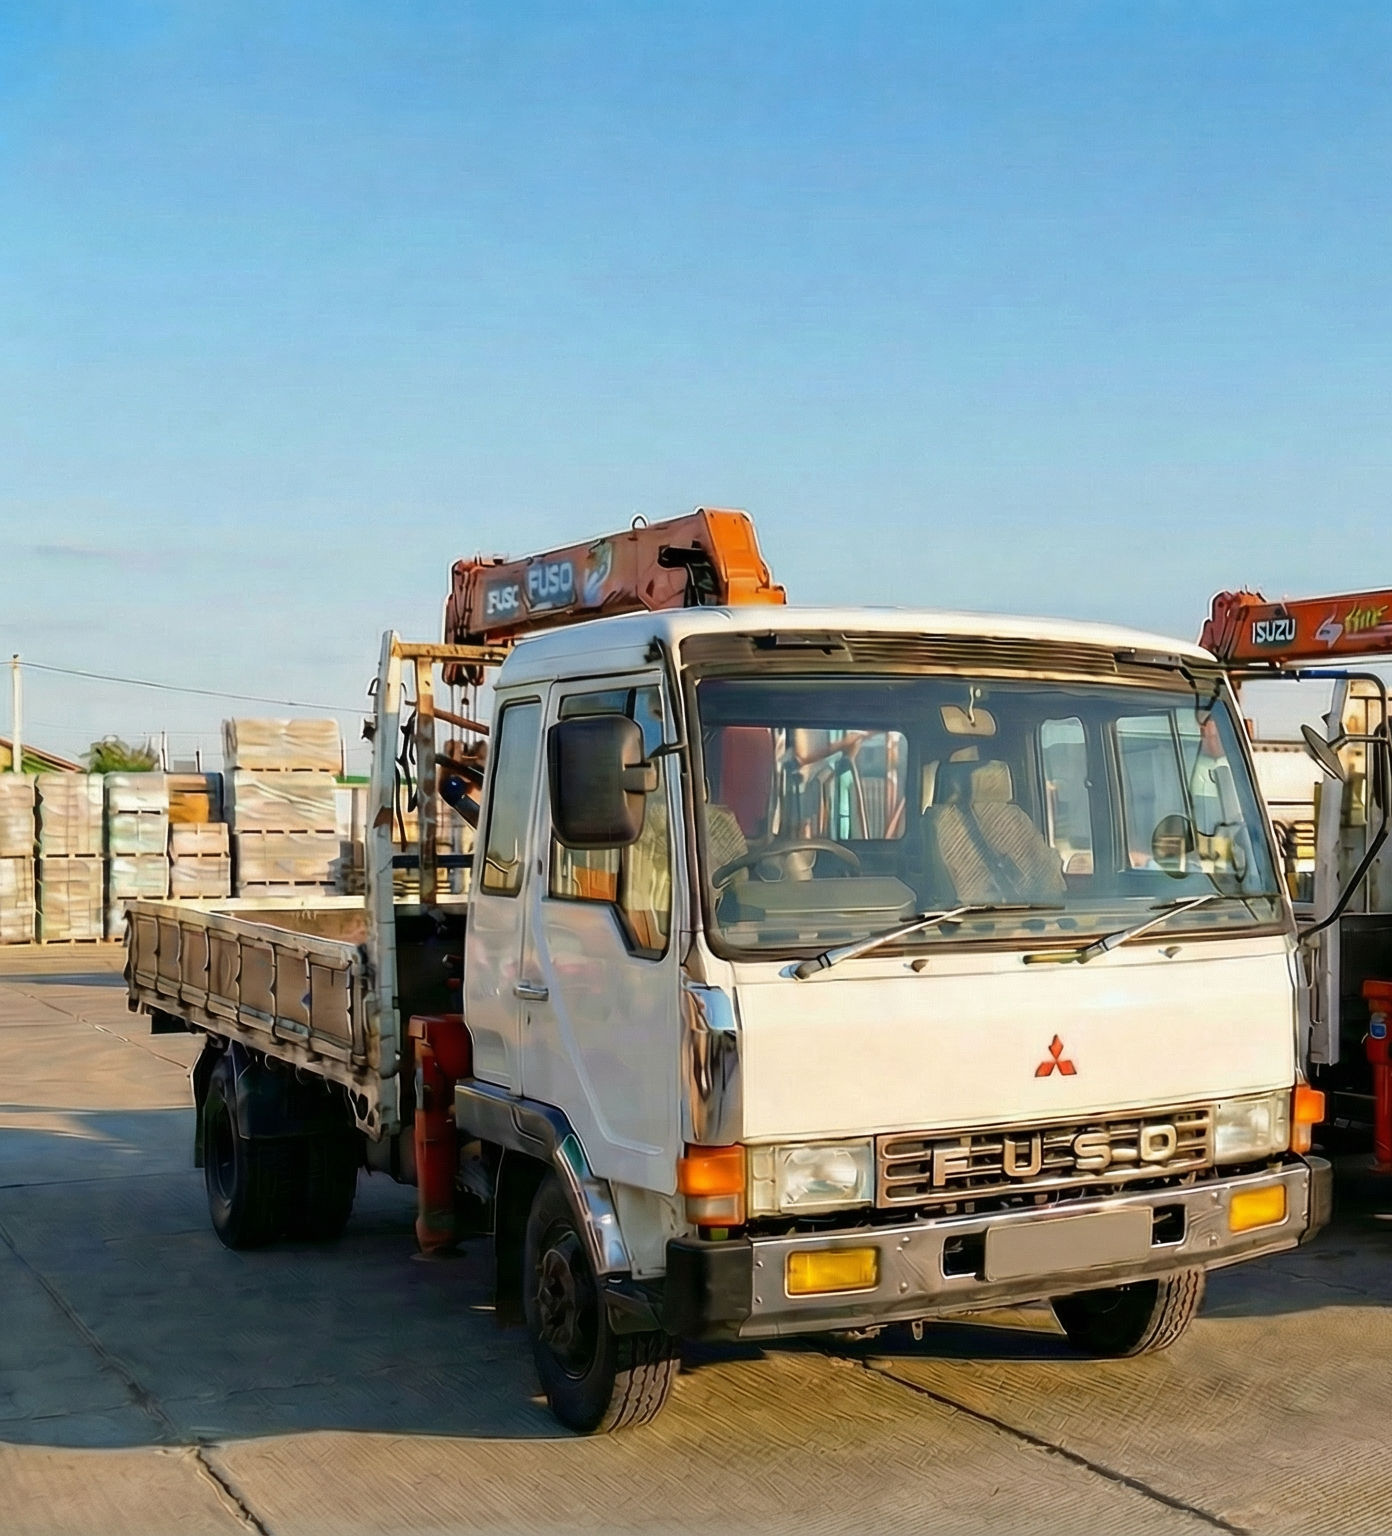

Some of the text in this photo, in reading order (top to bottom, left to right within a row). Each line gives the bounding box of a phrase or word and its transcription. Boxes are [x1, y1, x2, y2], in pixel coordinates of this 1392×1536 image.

[529, 562, 573, 600] FUSO
[1252, 618, 1296, 644] ISUZU
[932, 1124, 1178, 1187] FUSO
